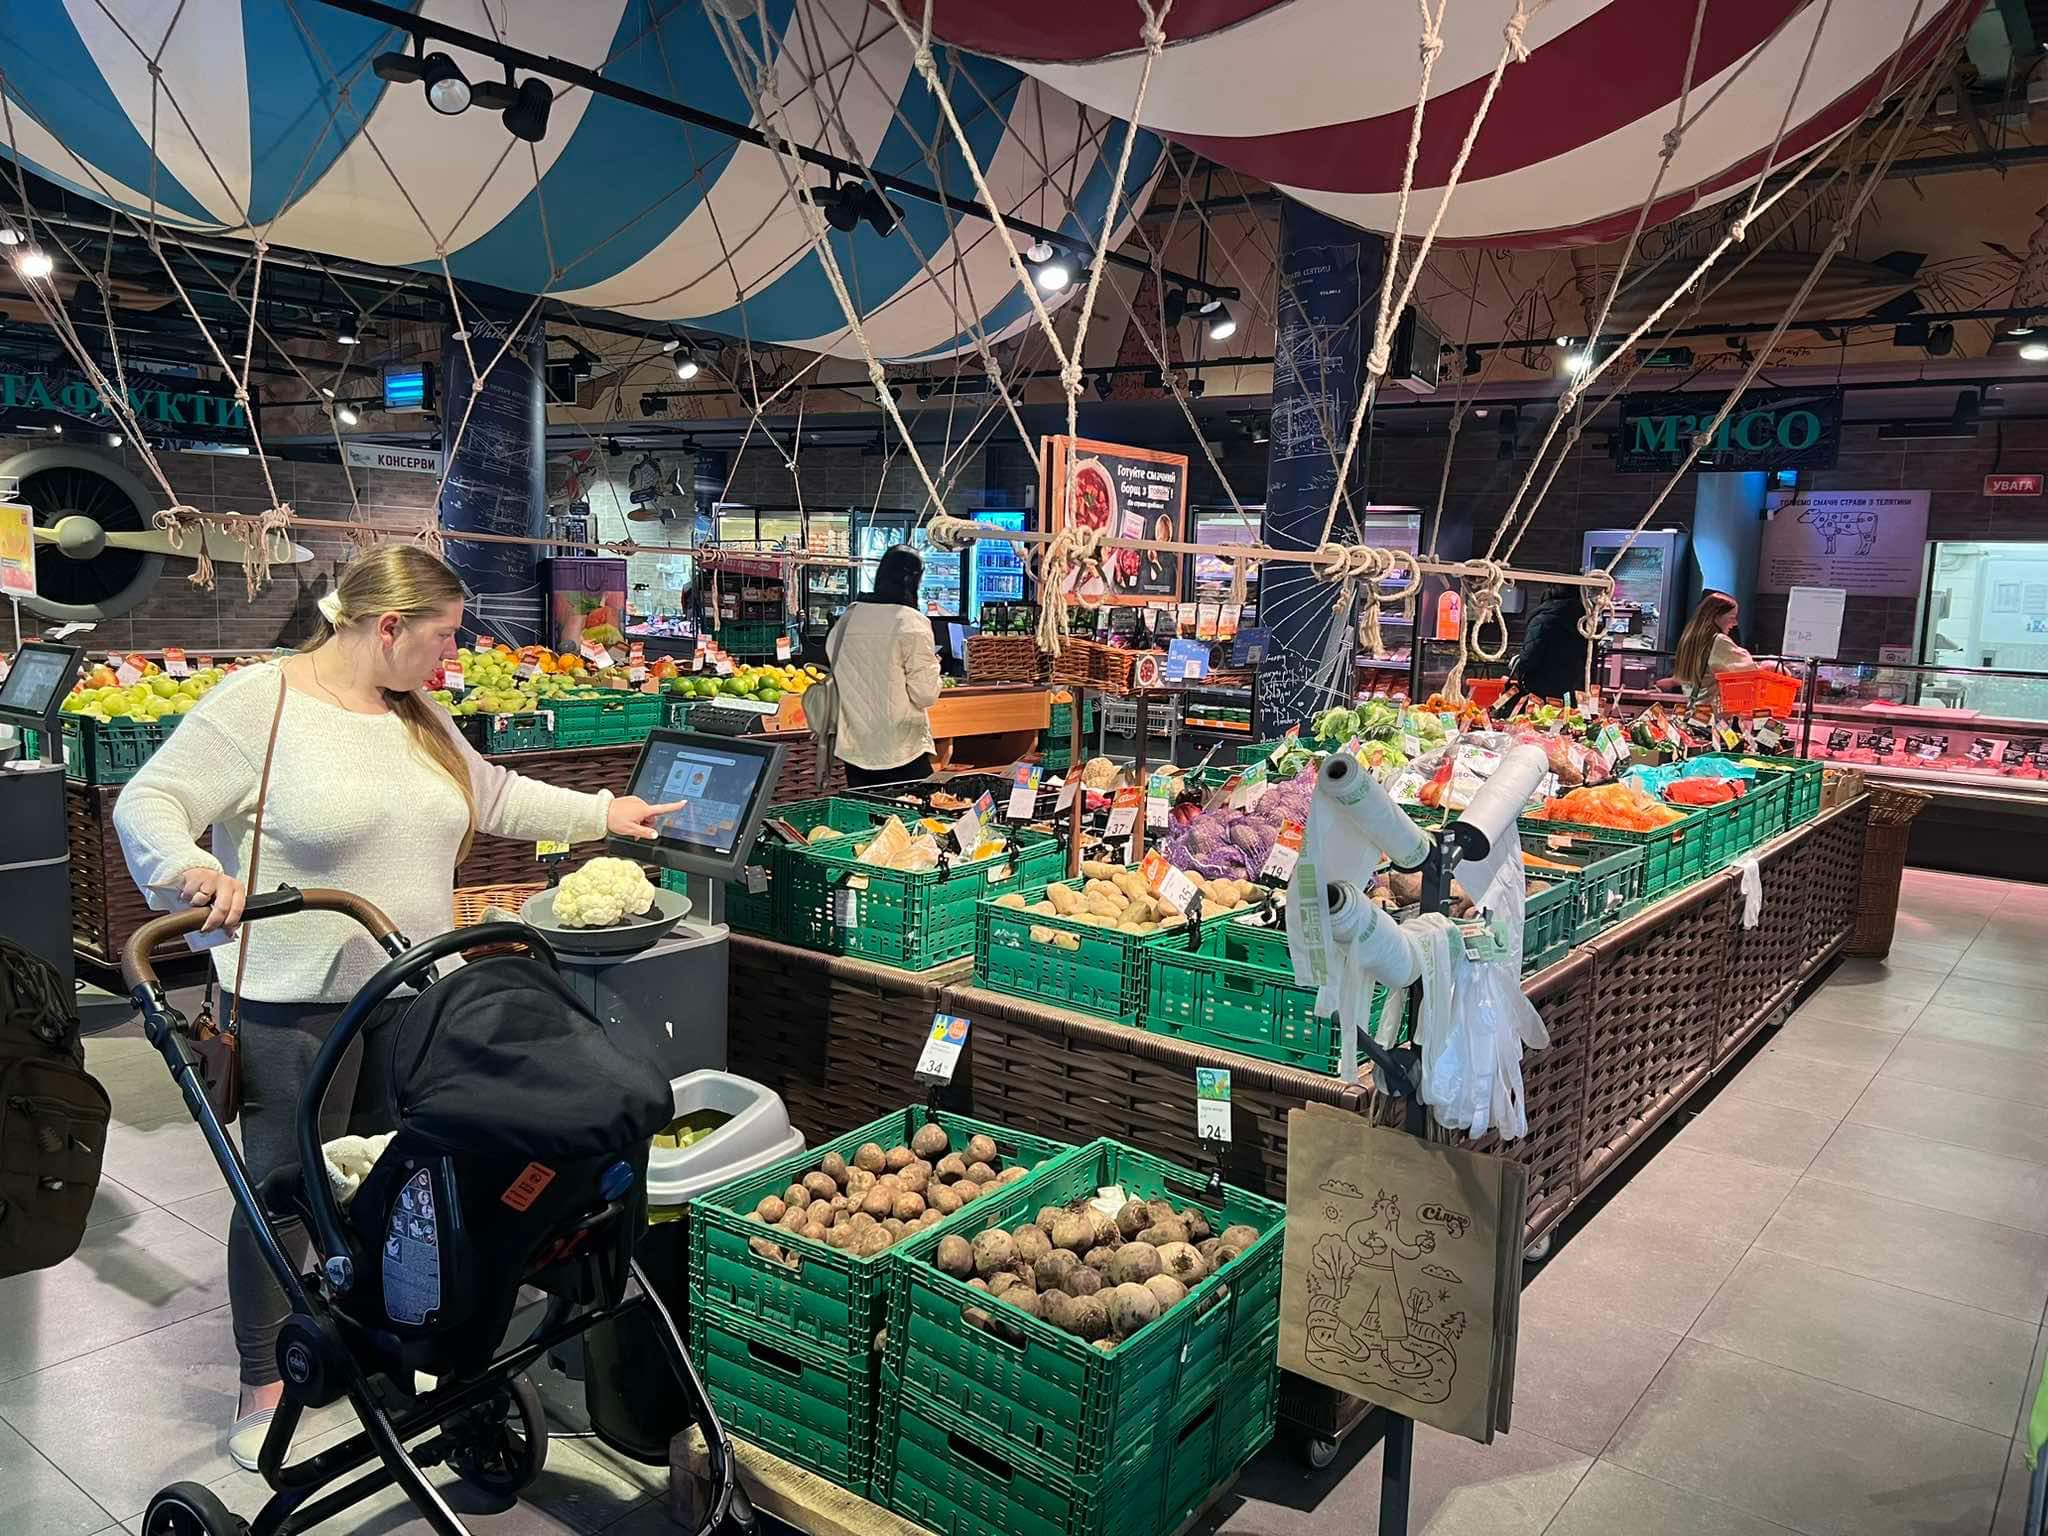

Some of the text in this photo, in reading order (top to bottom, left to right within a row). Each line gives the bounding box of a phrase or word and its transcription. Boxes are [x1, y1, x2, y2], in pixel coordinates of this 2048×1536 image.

[377, 454, 436, 471] КОНСЕРВИ
[1118, 463, 1176, 484] Готуйте смачний
[1120, 481, 1141, 498] борщ
[1993, 480, 2034, 491] УВАГА
[1111, 823, 1126, 835] 37
[926, 1060, 943, 1073] 34
[1206, 1125, 1221, 1138] 24
